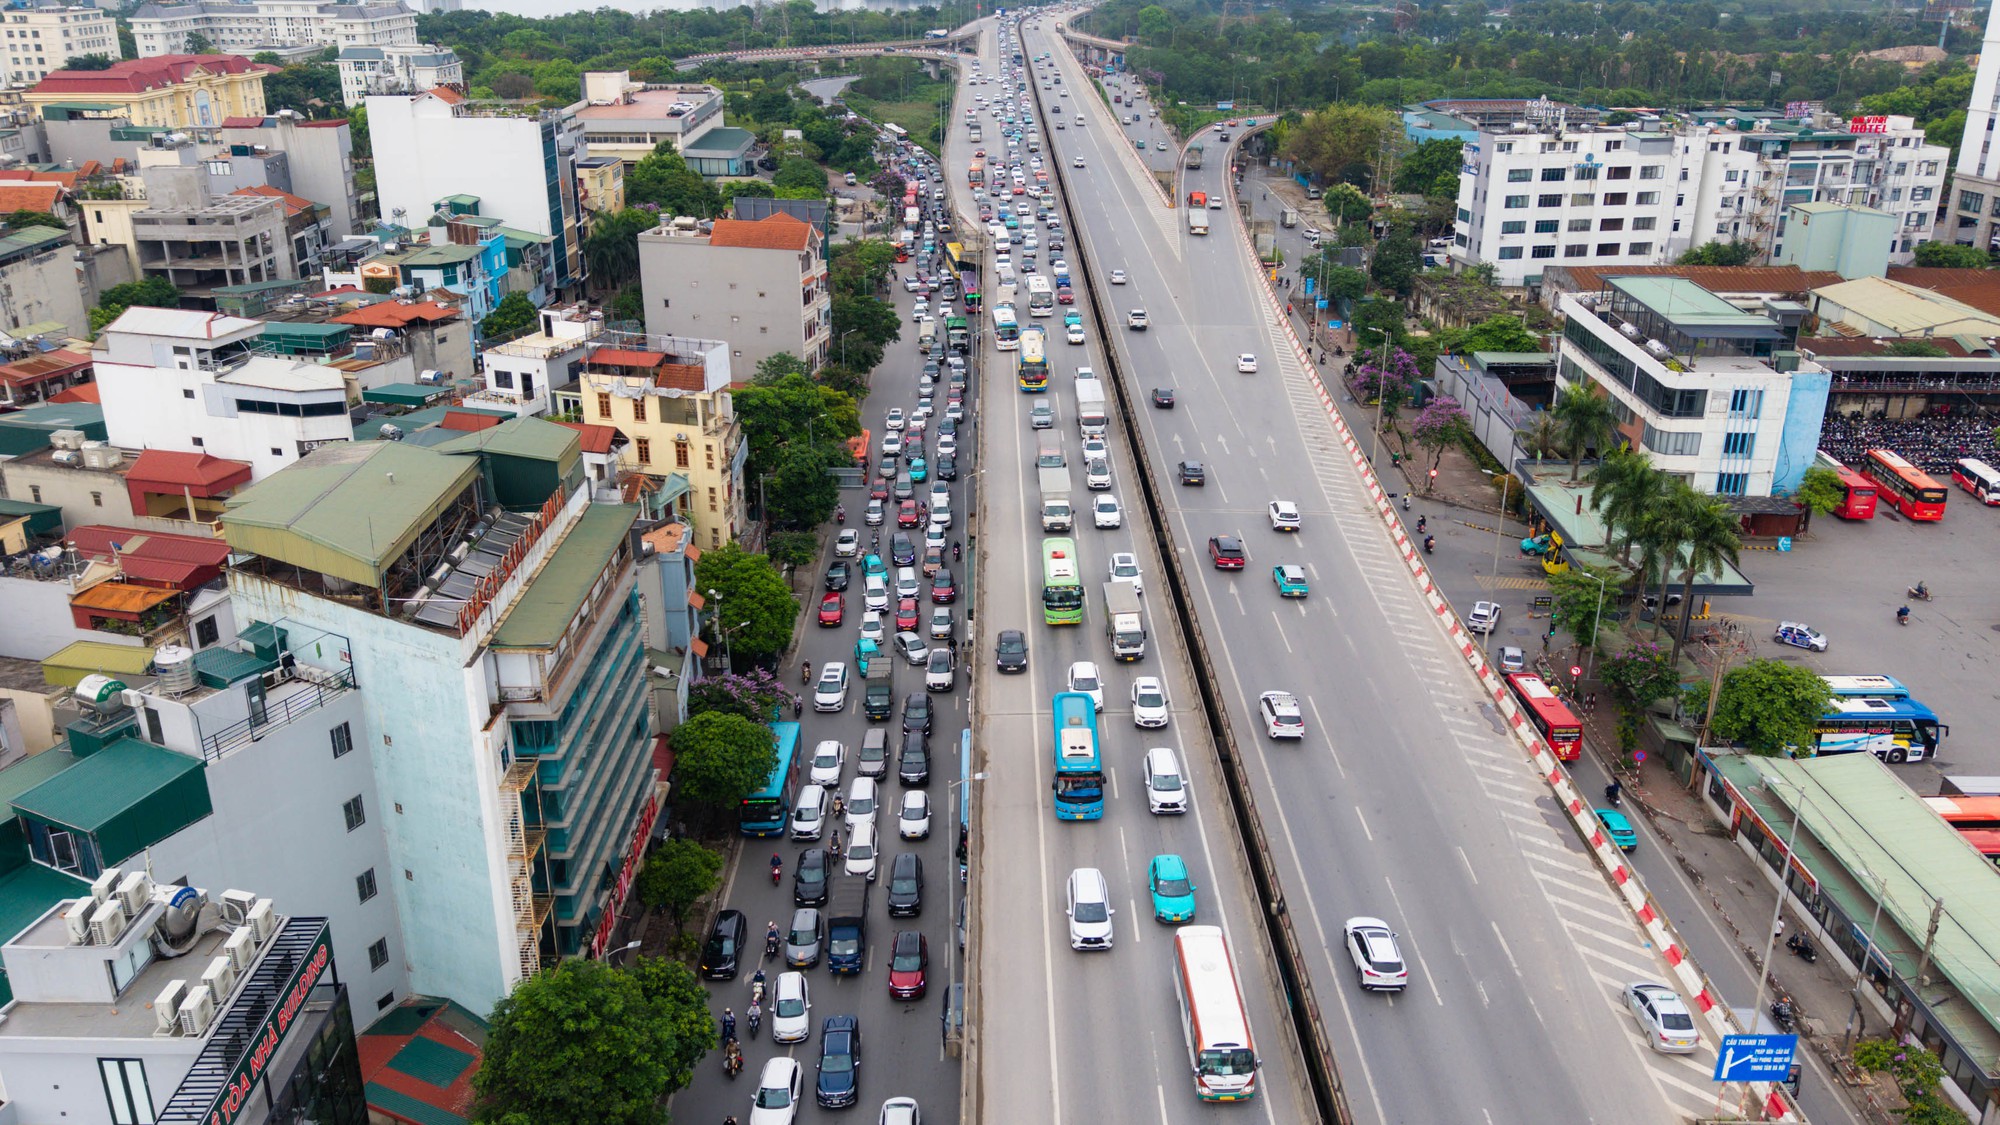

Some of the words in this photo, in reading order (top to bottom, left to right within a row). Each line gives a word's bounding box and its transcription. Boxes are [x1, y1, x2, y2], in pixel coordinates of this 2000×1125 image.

[1526, 100, 1555, 108] ROYAL
[1850, 124, 1888, 133] HOTEL
[221, 1072, 251, 1124] TÒA
[250, 1022, 279, 1080] NHÀ
[278, 943, 327, 1032] BUILDING
